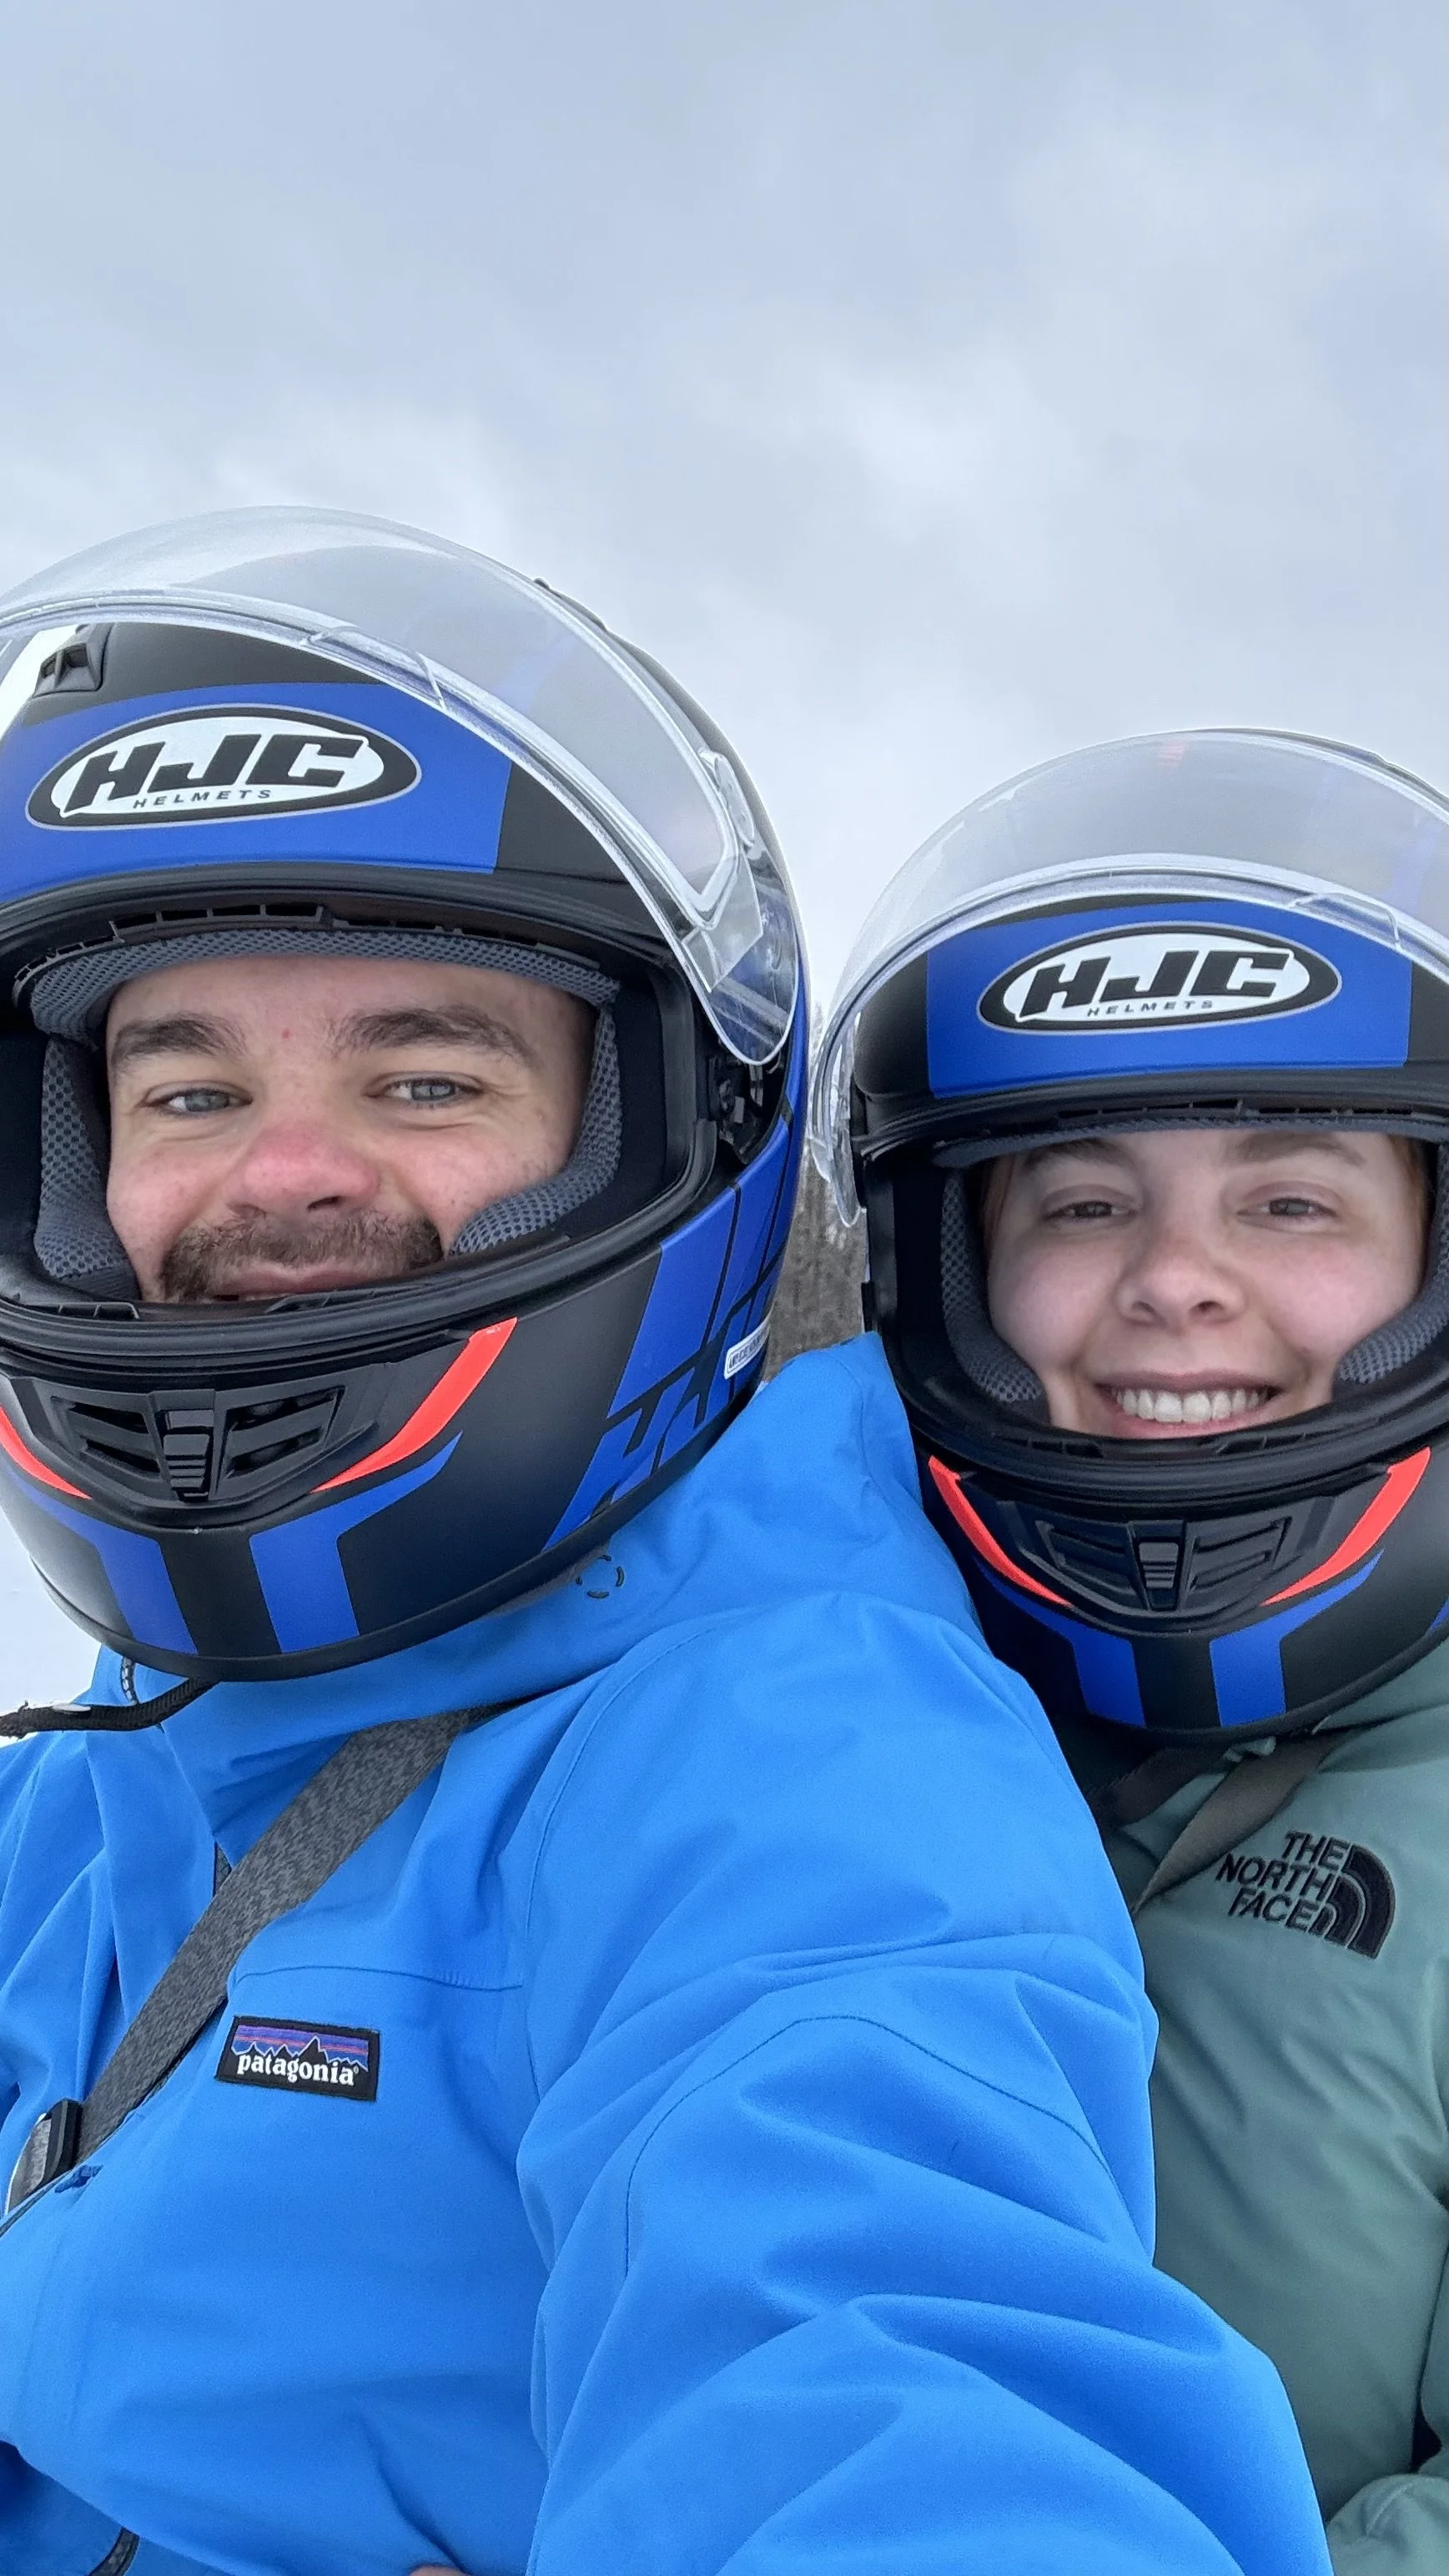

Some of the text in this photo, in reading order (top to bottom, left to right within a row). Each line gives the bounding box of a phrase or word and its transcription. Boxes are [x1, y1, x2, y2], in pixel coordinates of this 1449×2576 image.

[63, 734, 365, 813] HJC
[133, 789, 271, 809] HELMETS
[1019, 950, 1290, 1018] HJC
[1087, 1000, 1213, 1017] HELMETS
[1281, 1831, 1350, 1870] THE
[1215, 1854, 1335, 1901] NORTH
[1228, 1888, 1319, 1933] FACE
